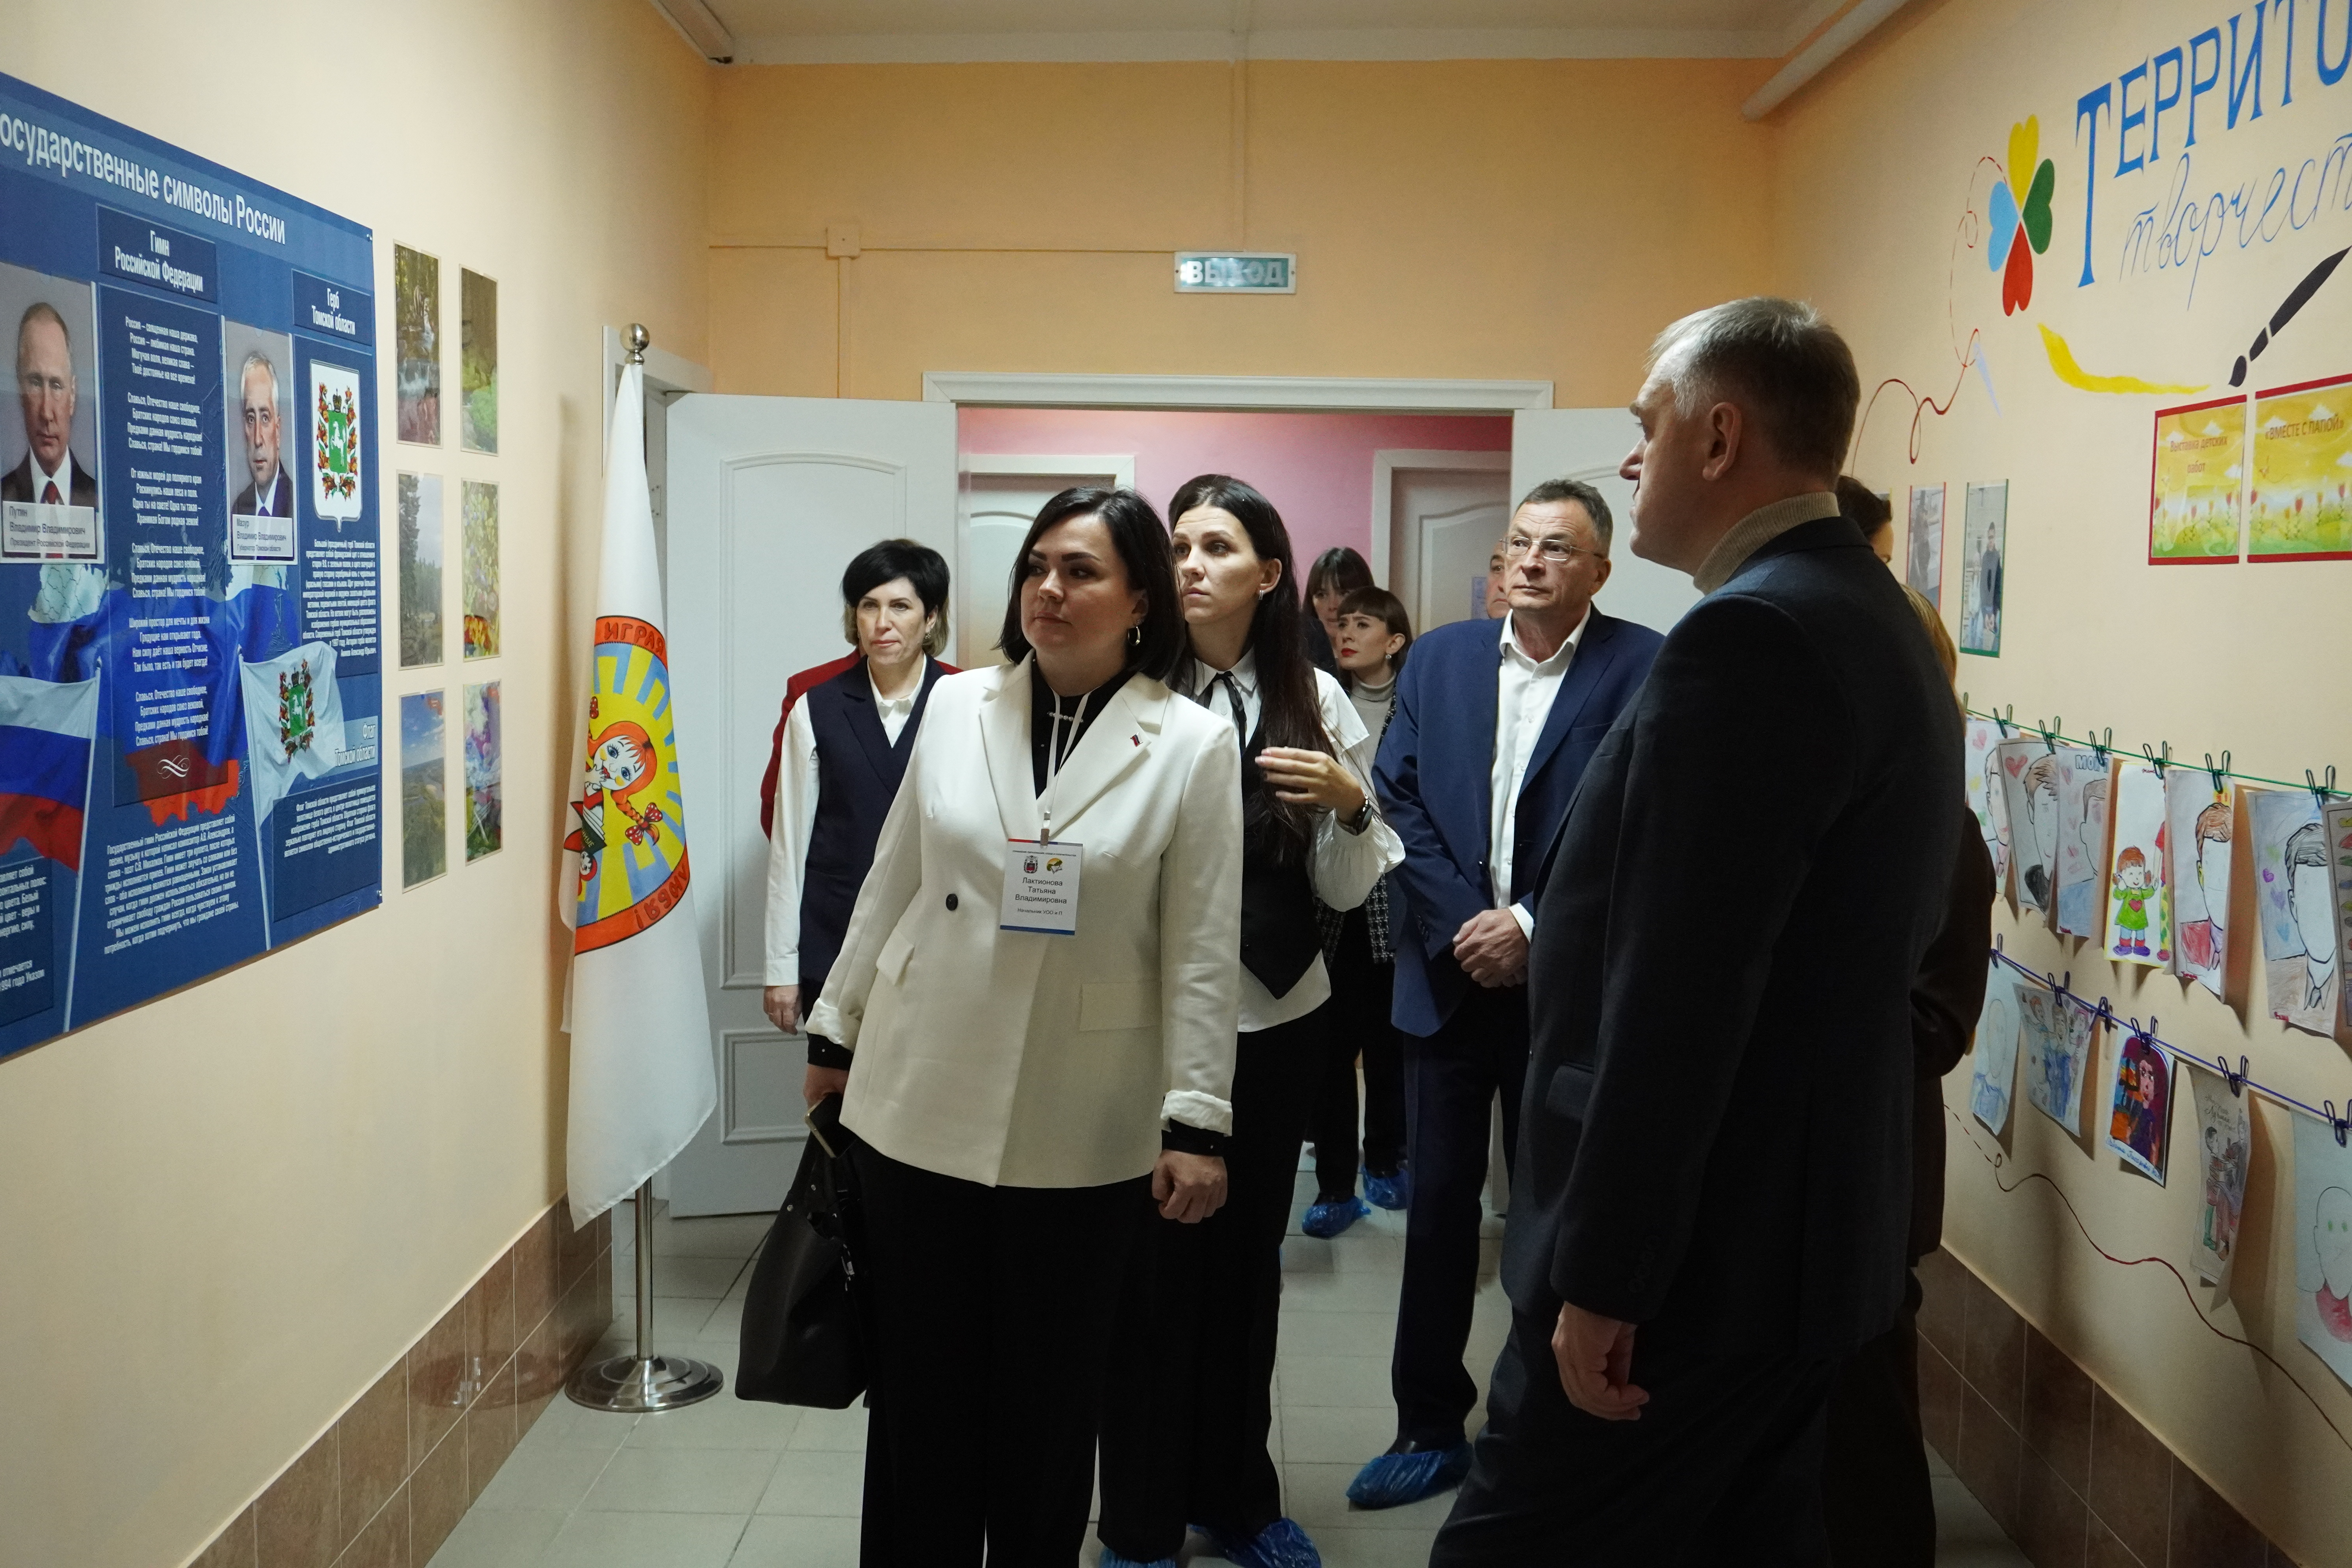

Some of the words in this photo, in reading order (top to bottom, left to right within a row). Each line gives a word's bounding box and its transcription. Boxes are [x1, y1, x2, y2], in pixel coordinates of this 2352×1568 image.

[0, 113, 159, 199] осударственные
[163, 175, 233, 226] символы
[236, 194, 285, 245] России
[150, 230, 170, 257] Гимн
[115, 245, 161, 280] Российской
[162, 261, 203, 294] Федерации
[327, 288, 339, 312] Герб
[311, 305, 334, 329] Томской
[335, 313, 356, 335] области
[2265, 423, 2301, 440] «ВМЕСТЕ
[2301, 422, 2308, 436] С
[2308, 412, 2345, 434] ПАПОЙ»
[2170, 439, 2200, 453] Выставка
[2200, 435, 2228, 451] детских
[2187, 459, 2206, 474] работ
[9, 506, 27, 519] Путин
[9, 521, 41, 535] Владимир
[42, 523, 85, 535] Владимирович
[237, 518, 249, 529] Мазур
[237, 531, 258, 542] Владимир
[258, 532, 287, 543] Владимирович
[604, 621, 664, 656] ИГРАЯ
[362, 722, 376, 739] Флаг
[334, 745, 356, 768] Томской
[356, 743, 376, 763] области
[1022, 877, 1063, 886] Лактионова
[1015, 894, 1067, 904] Владимировна
[1028, 886, 1056, 895] Татьяна
